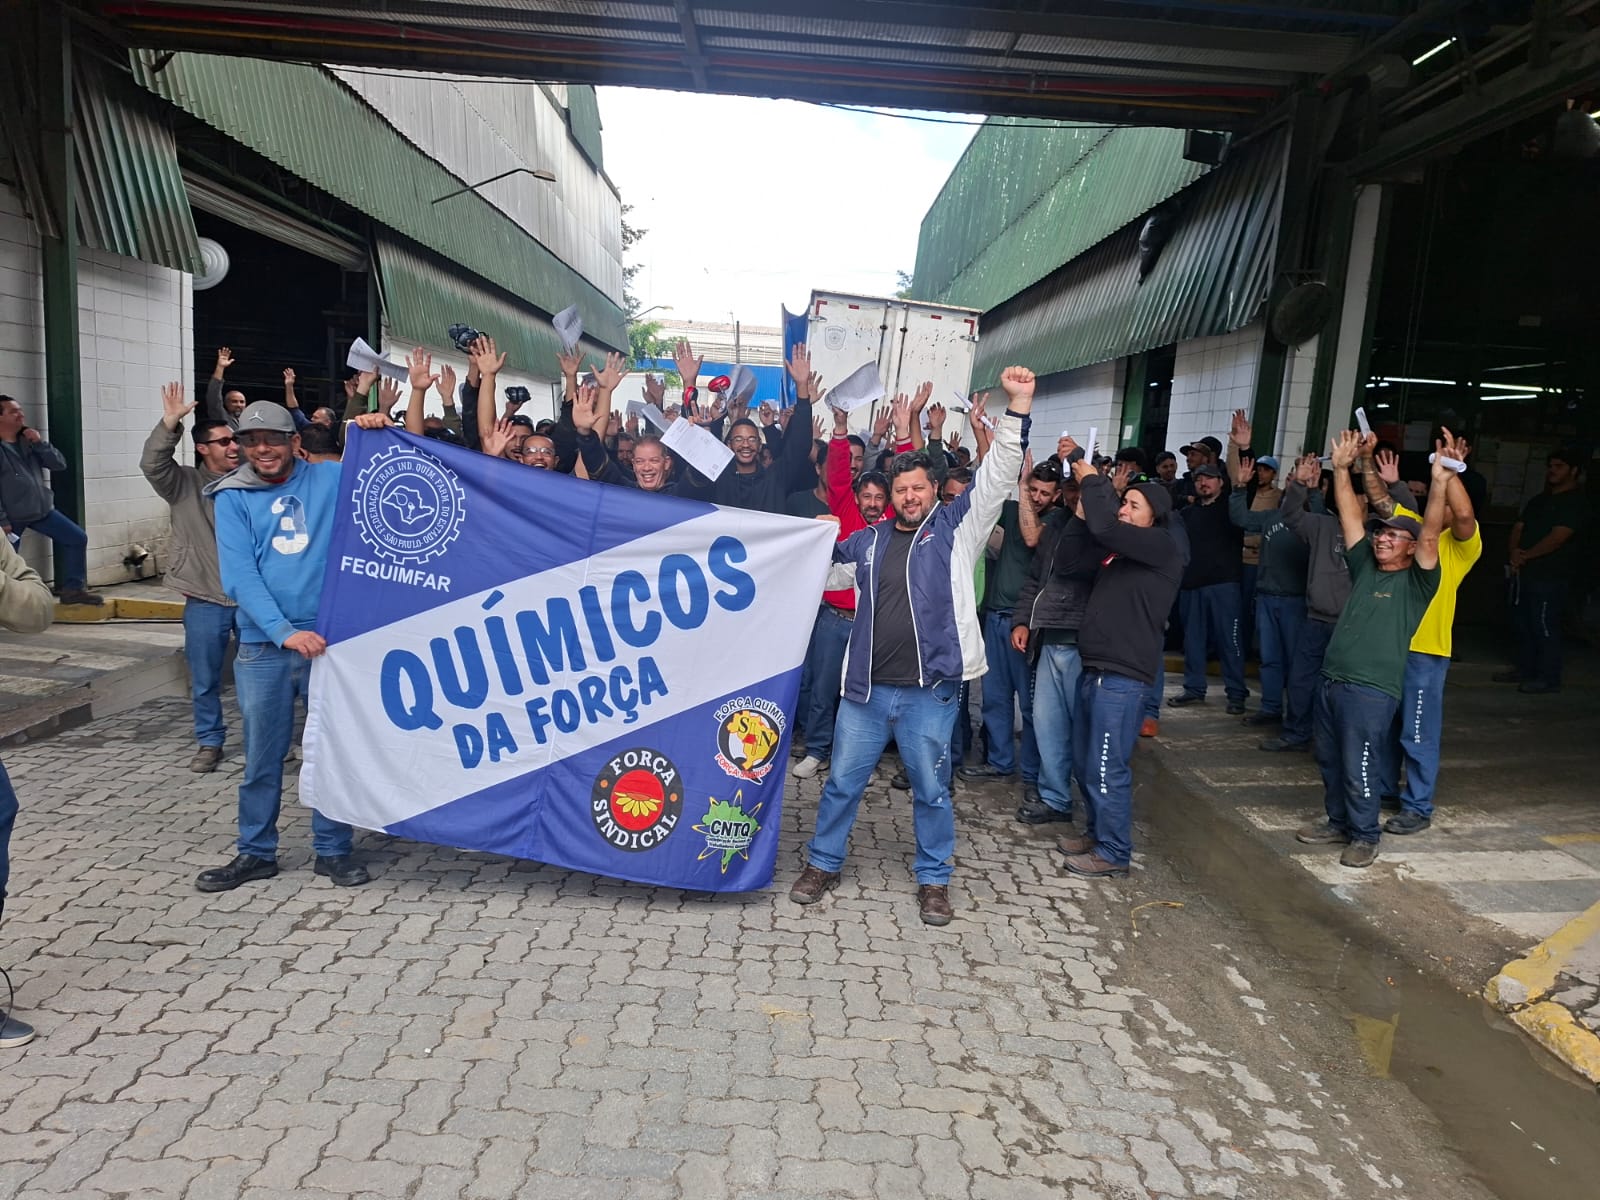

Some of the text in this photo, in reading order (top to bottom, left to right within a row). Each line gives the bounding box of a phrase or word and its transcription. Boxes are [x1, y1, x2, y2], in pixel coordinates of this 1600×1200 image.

[271, 494, 309, 555] 3
[422, 517, 447, 544] ESTADO
[441, 506, 450, 518] DO
[340, 555, 451, 593] FEQUIMFAR
[380, 535, 756, 731] QUÍMICOS
[453, 656, 669, 769] DA FORÇA
[714, 697, 752, 721] FORÇA
[609, 750, 676, 786] FORÇA
[593, 798, 678, 849] SINDICAL
[710, 820, 751, 837] CNTQ
